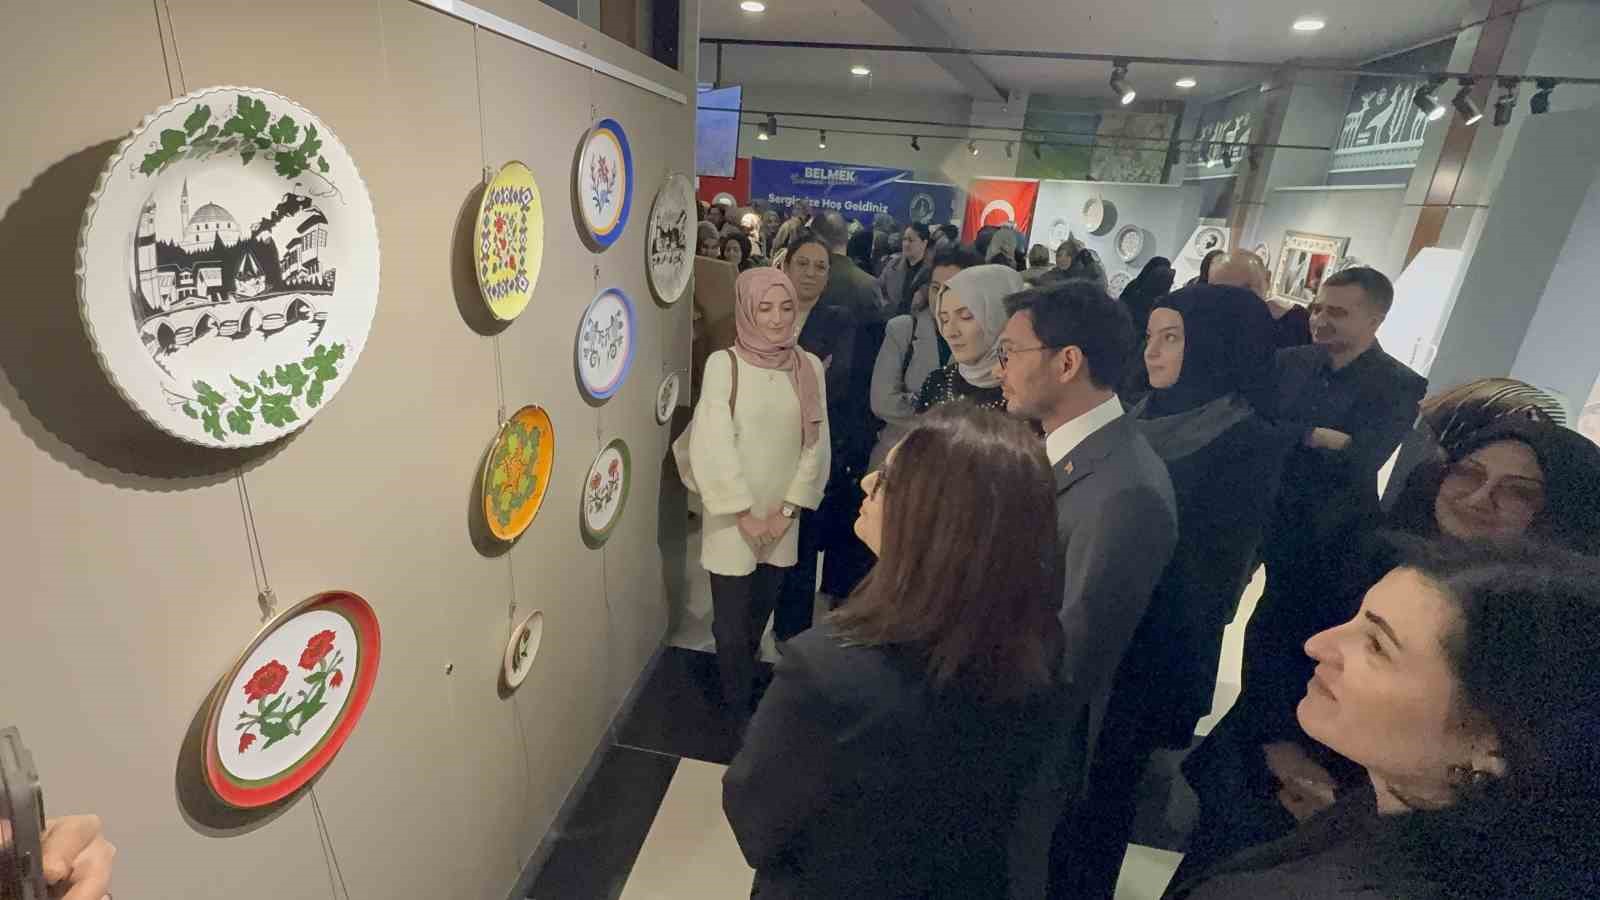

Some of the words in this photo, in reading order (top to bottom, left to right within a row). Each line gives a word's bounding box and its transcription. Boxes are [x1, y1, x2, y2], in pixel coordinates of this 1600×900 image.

[804, 167, 855, 181] BELMEK
[768, 193, 820, 208] Sergize
[844, 200, 888, 213] Geldiniz
